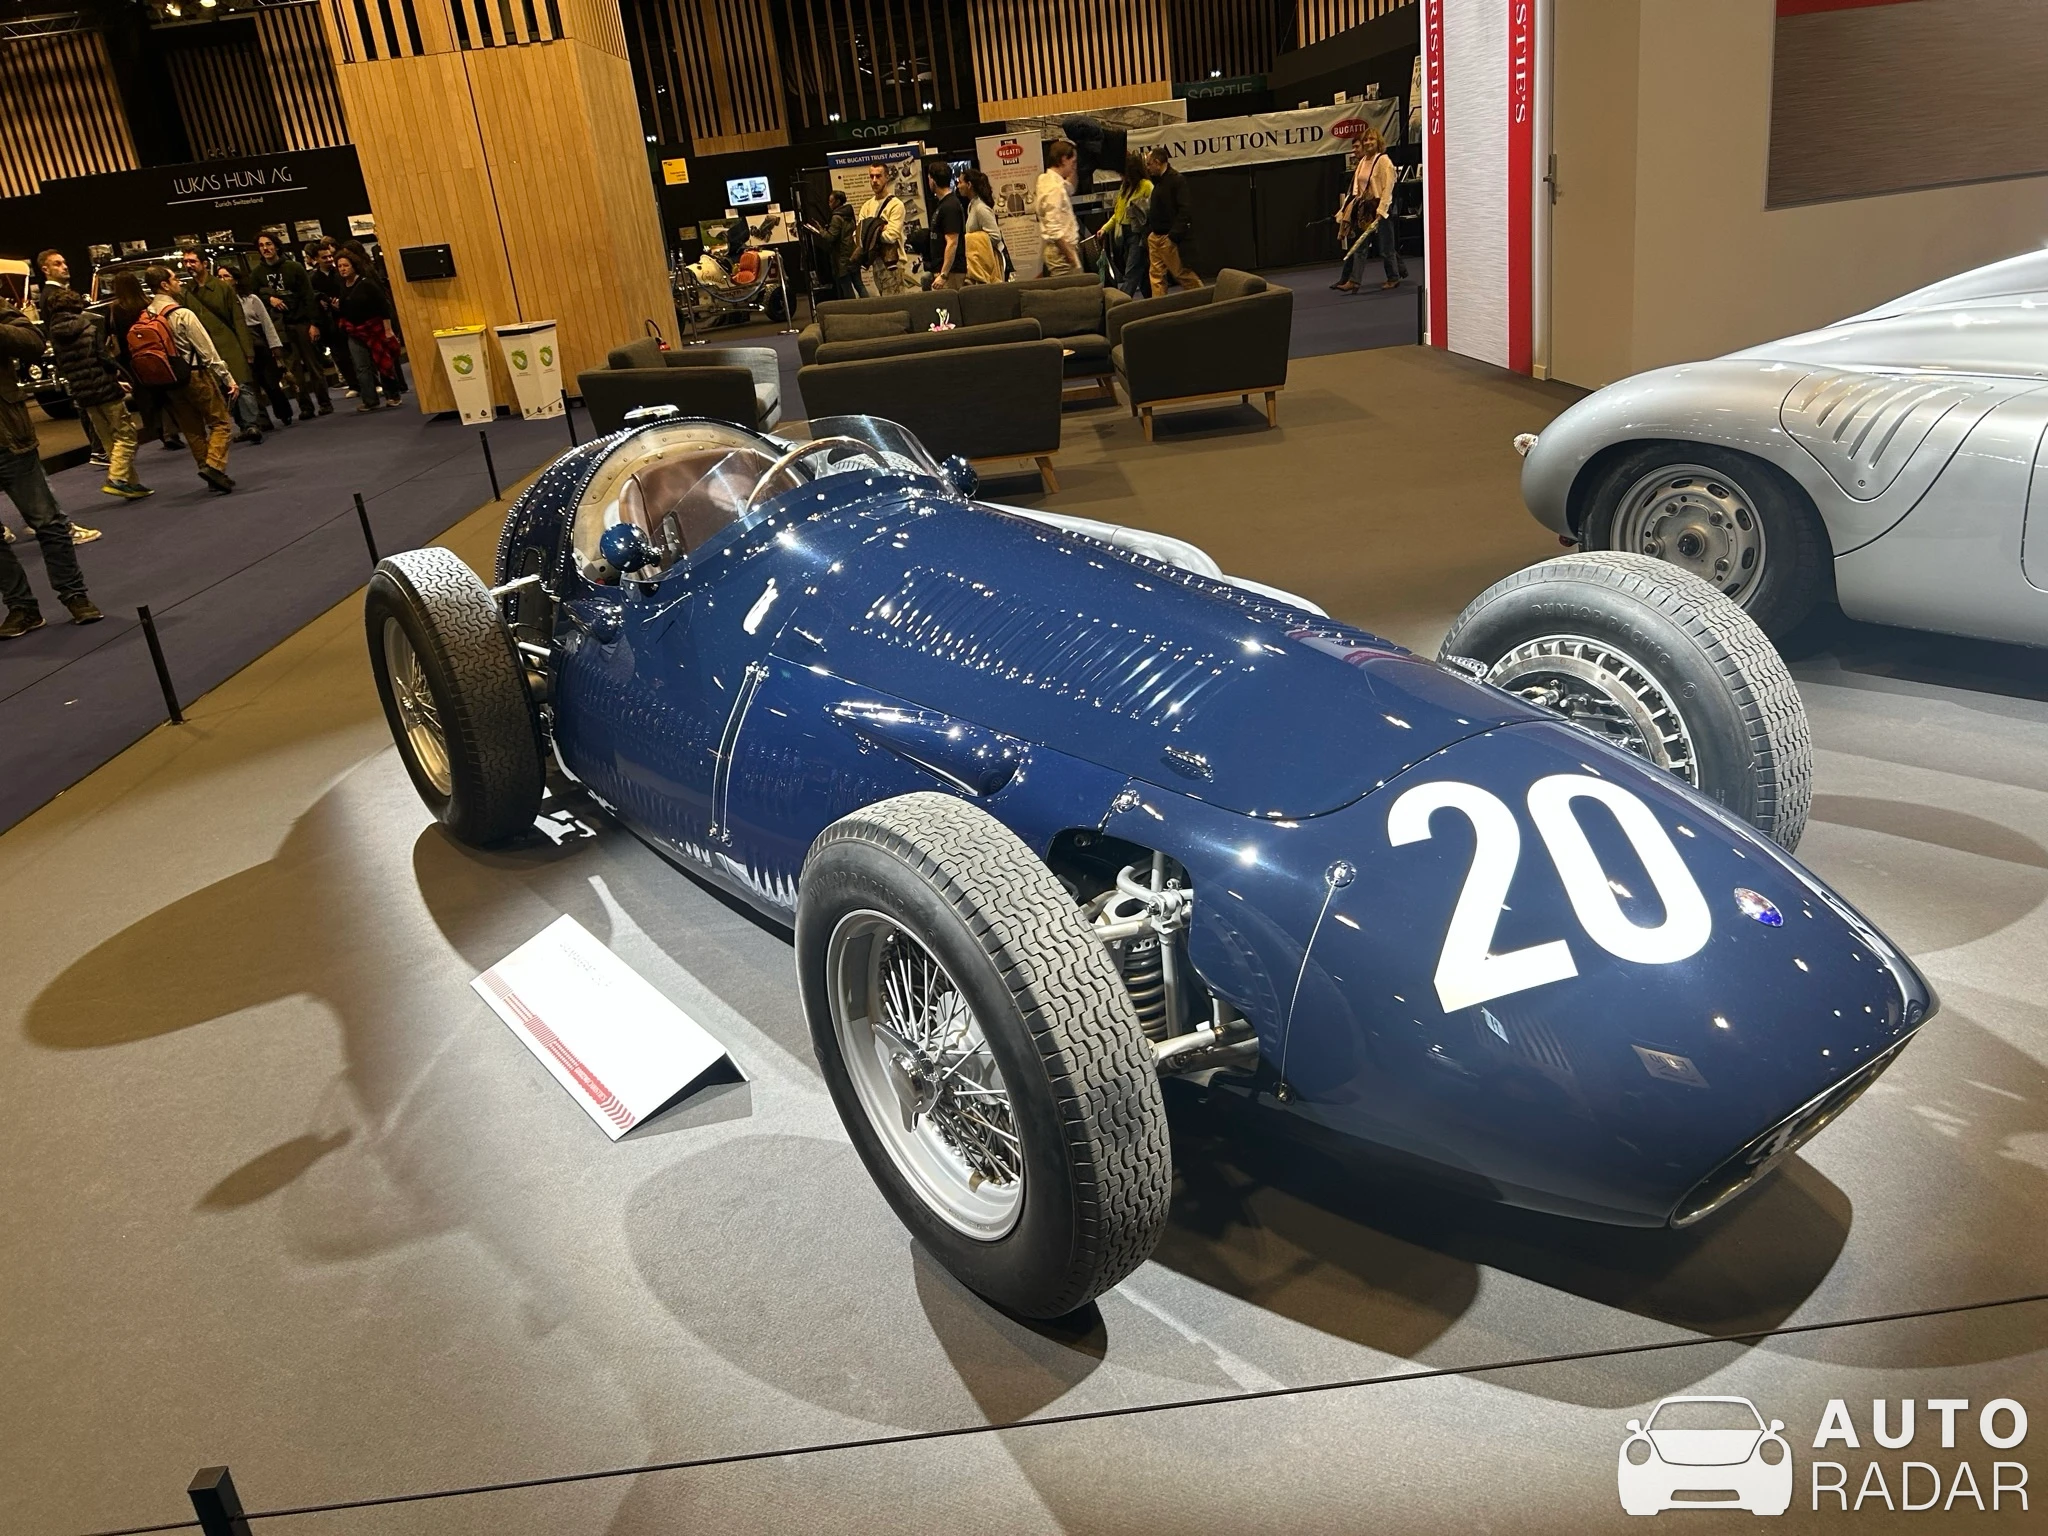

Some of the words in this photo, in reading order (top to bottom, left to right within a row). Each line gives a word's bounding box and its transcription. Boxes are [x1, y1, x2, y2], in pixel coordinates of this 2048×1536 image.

[1515, 0, 1527, 124] STIE'S
[1192, 130, 1279, 156] DUTTON
[1285, 125, 1324, 145] LTD
[1333, 124, 1366, 136] BUGATTI
[847, 155, 870, 164] BUGATTI
[870, 153, 888, 161] TRUST
[888, 151, 911, 160] ARCHIVE
[173, 174, 221, 195] LUKAS
[271, 166, 292, 184] AG
[233, 196, 264, 206] Switzerland
[1530, 602, 1602, 621] DUNLOP
[1606, 615, 1671, 665] RACING
[1387, 774, 1713, 1014] 20
